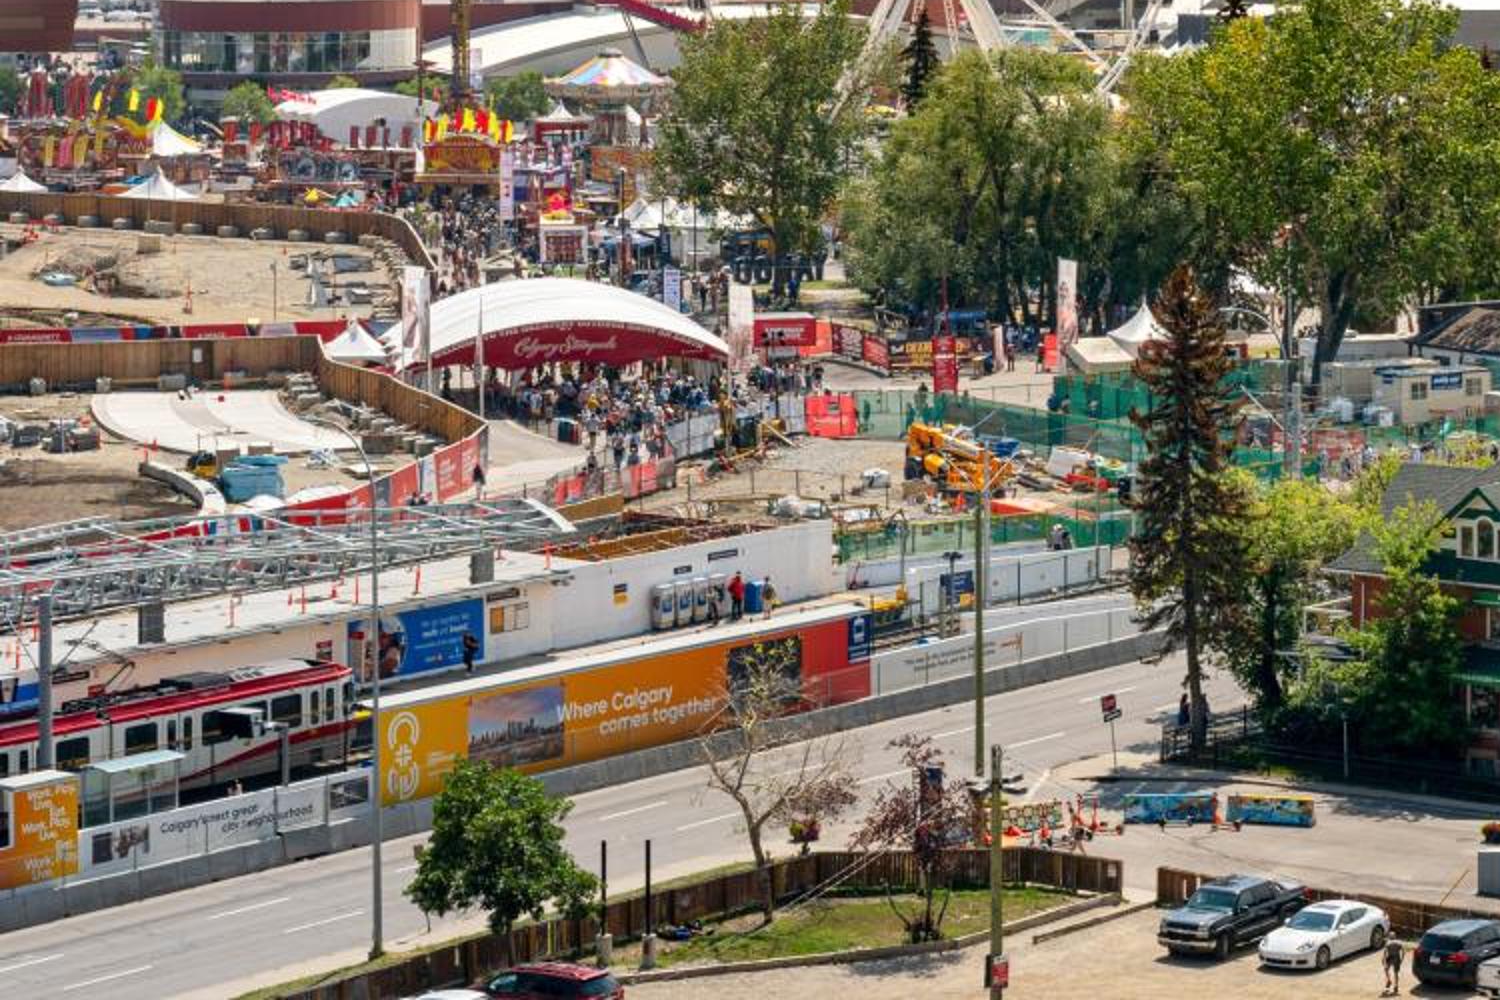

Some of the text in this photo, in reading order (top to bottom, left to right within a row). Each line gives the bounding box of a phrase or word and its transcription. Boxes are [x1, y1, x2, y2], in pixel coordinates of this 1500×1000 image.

[513, 334, 618, 360] Calgary Stampede
[556, 685, 673, 722] Where Calgary
[599, 695, 716, 735] comes together
[231, 803, 257, 820] great
